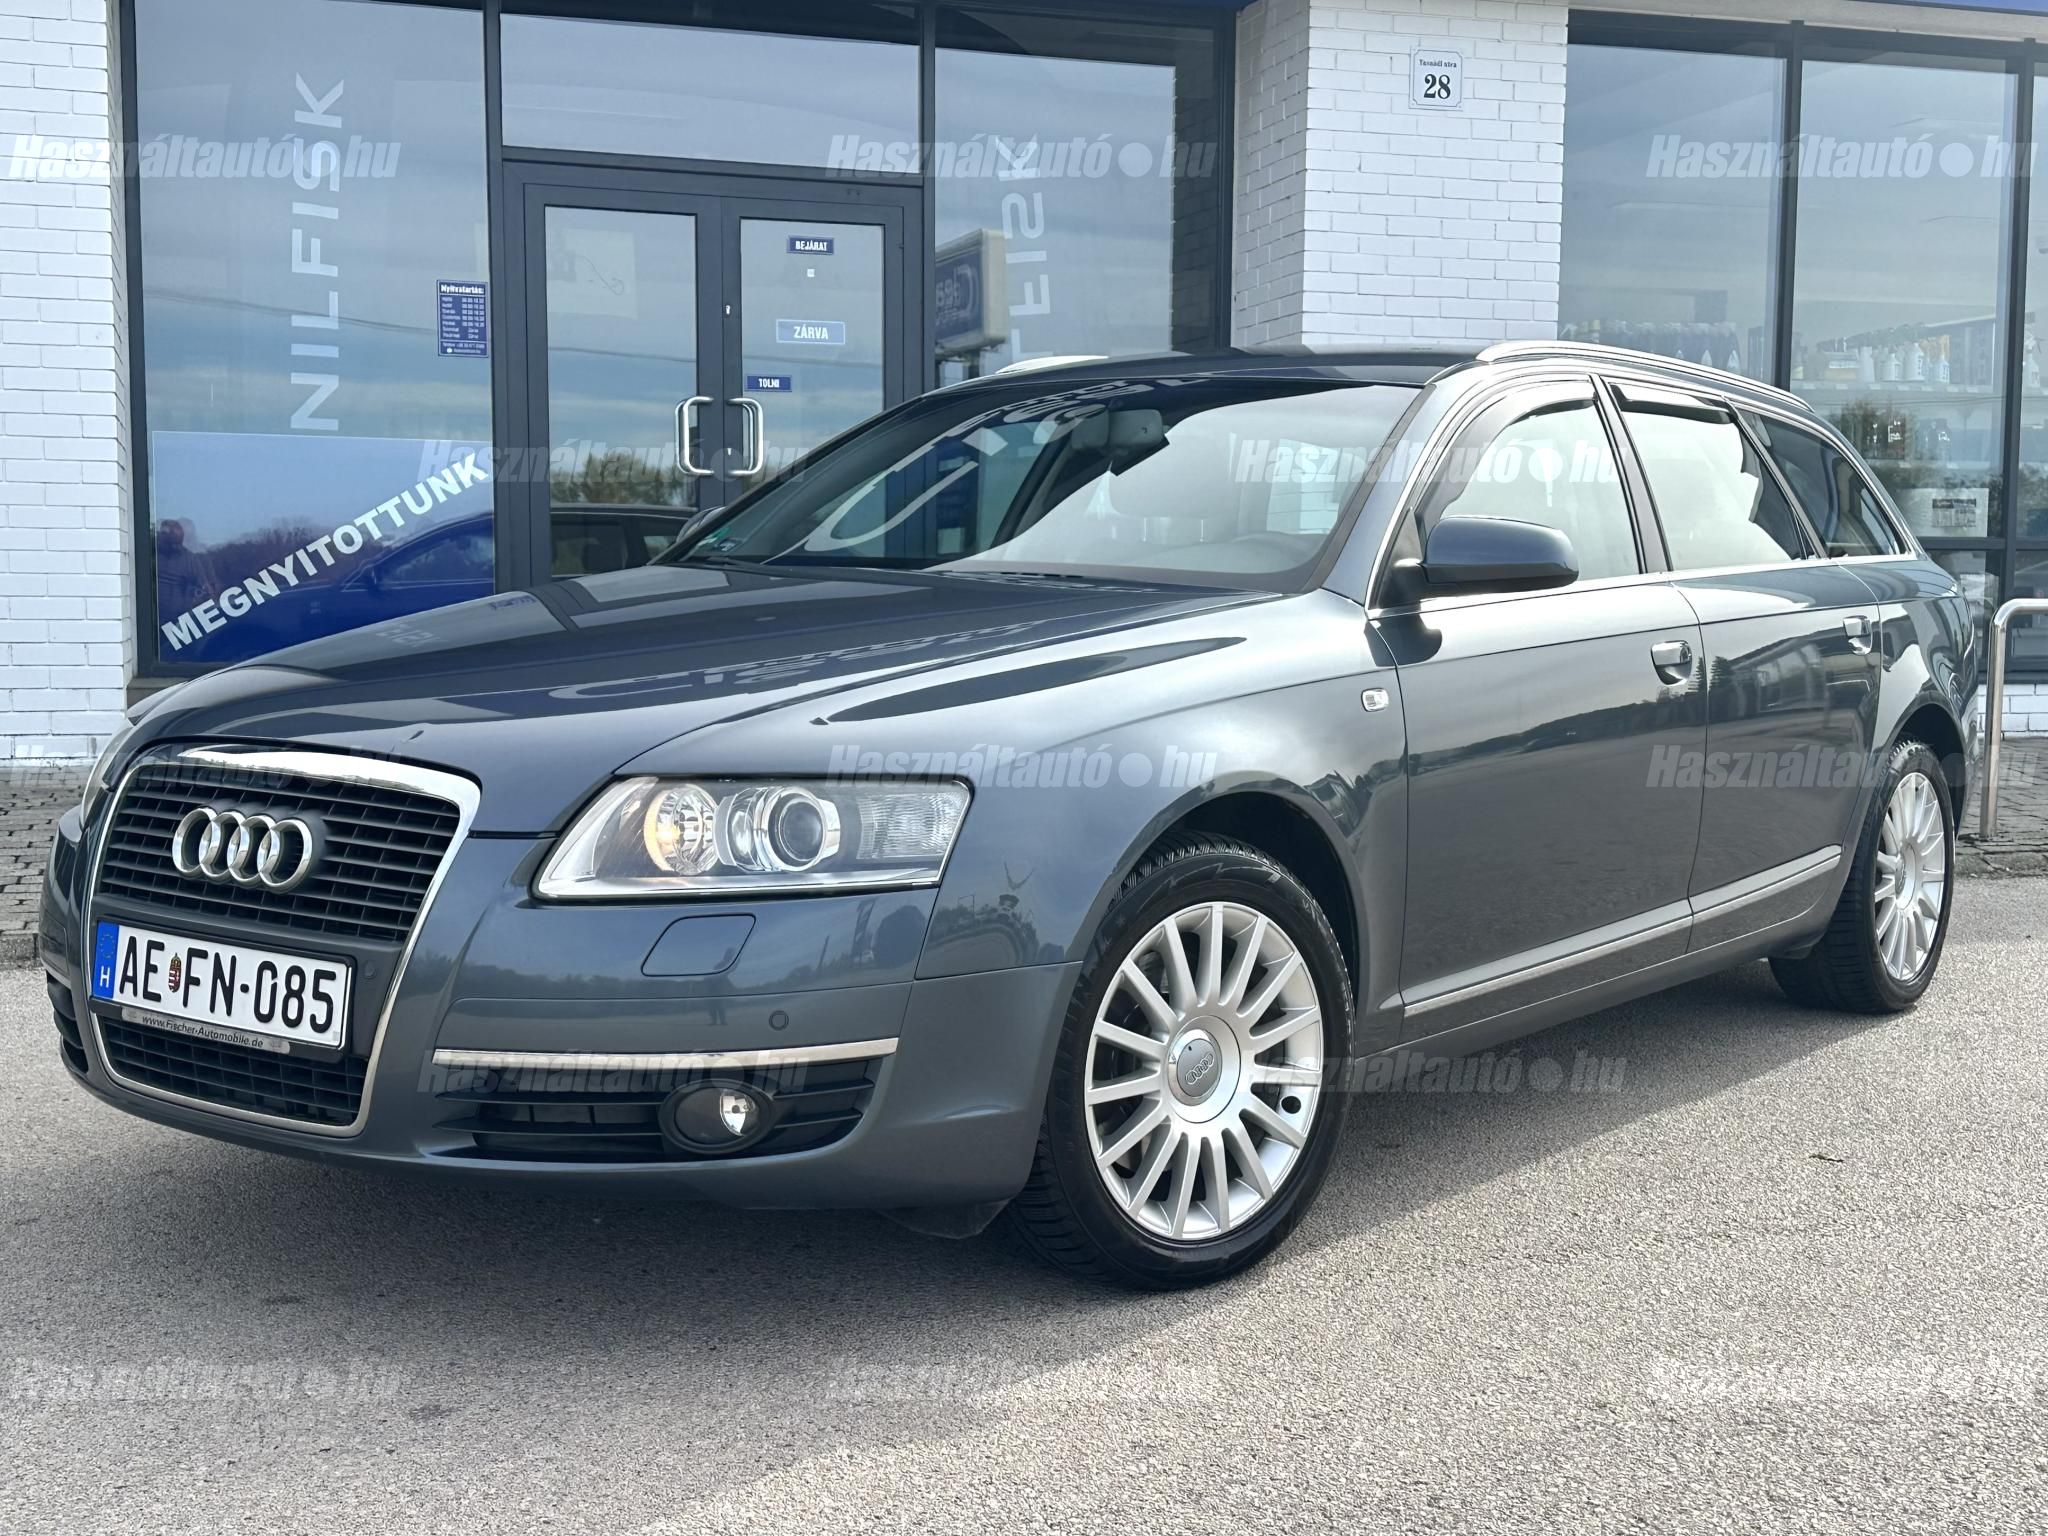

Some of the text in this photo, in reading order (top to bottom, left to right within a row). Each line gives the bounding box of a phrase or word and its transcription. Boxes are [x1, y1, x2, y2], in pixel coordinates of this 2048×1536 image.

[1423, 73, 1451, 100] 28
[290, 71, 344, 432] NILFISK
[795, 239, 828, 252] BEJÁRAT
[793, 323, 829, 340] ZÁRVA
[758, 378, 780, 388] TOLNI
[161, 452, 489, 651] MEGNYITOTTUNK
[99, 965, 111, 988] H
[119, 935, 337, 1034] AE FN-085
[142, 1014, 264, 1049] www.Fischer-Automobile.de
